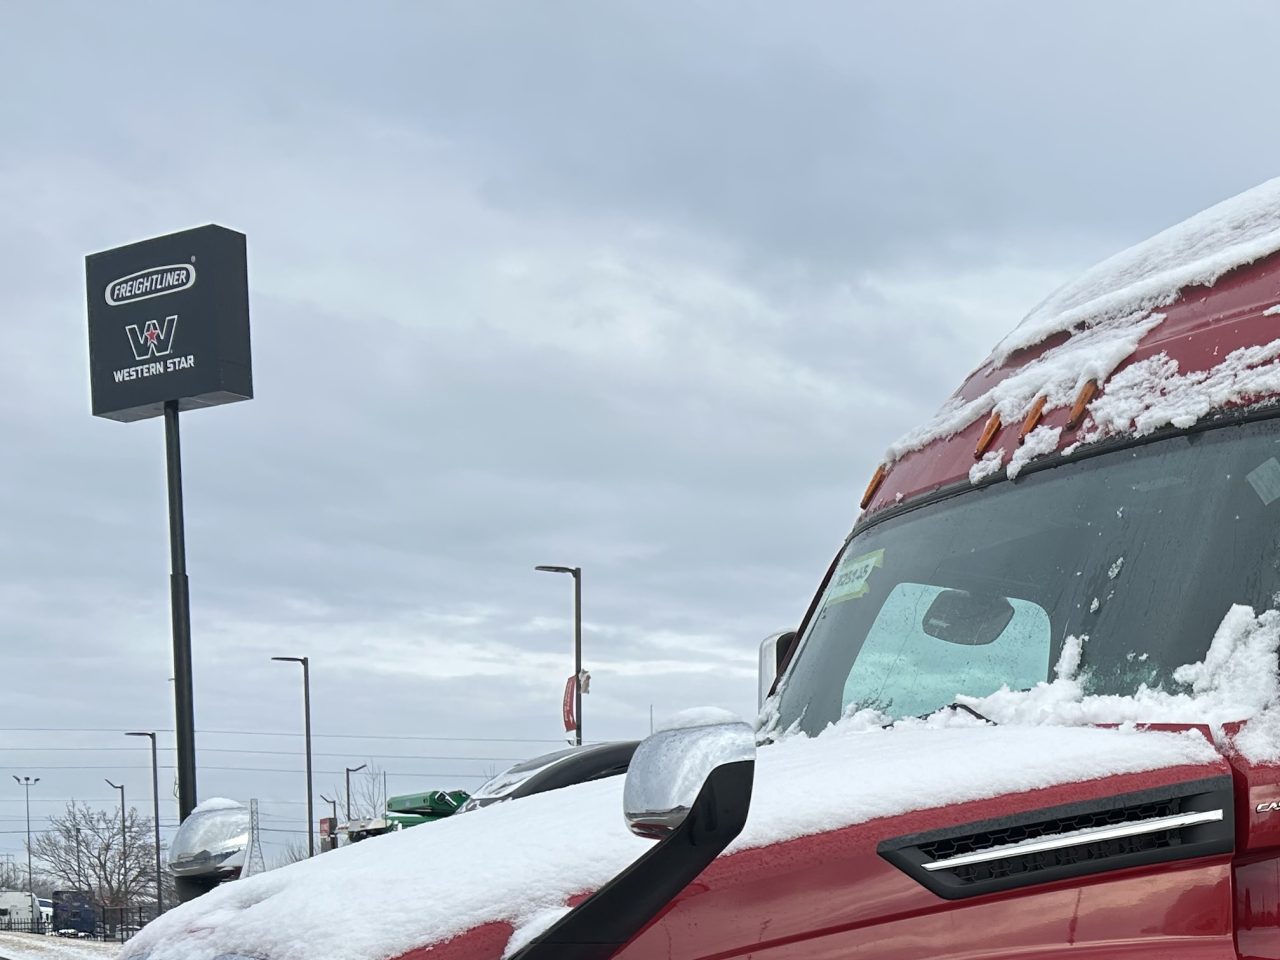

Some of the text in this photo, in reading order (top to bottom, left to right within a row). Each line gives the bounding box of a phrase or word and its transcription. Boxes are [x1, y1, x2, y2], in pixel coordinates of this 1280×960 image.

[113, 270, 187, 300] FREIGHTLINER
[113, 354, 195, 383] WESTERN STAR
